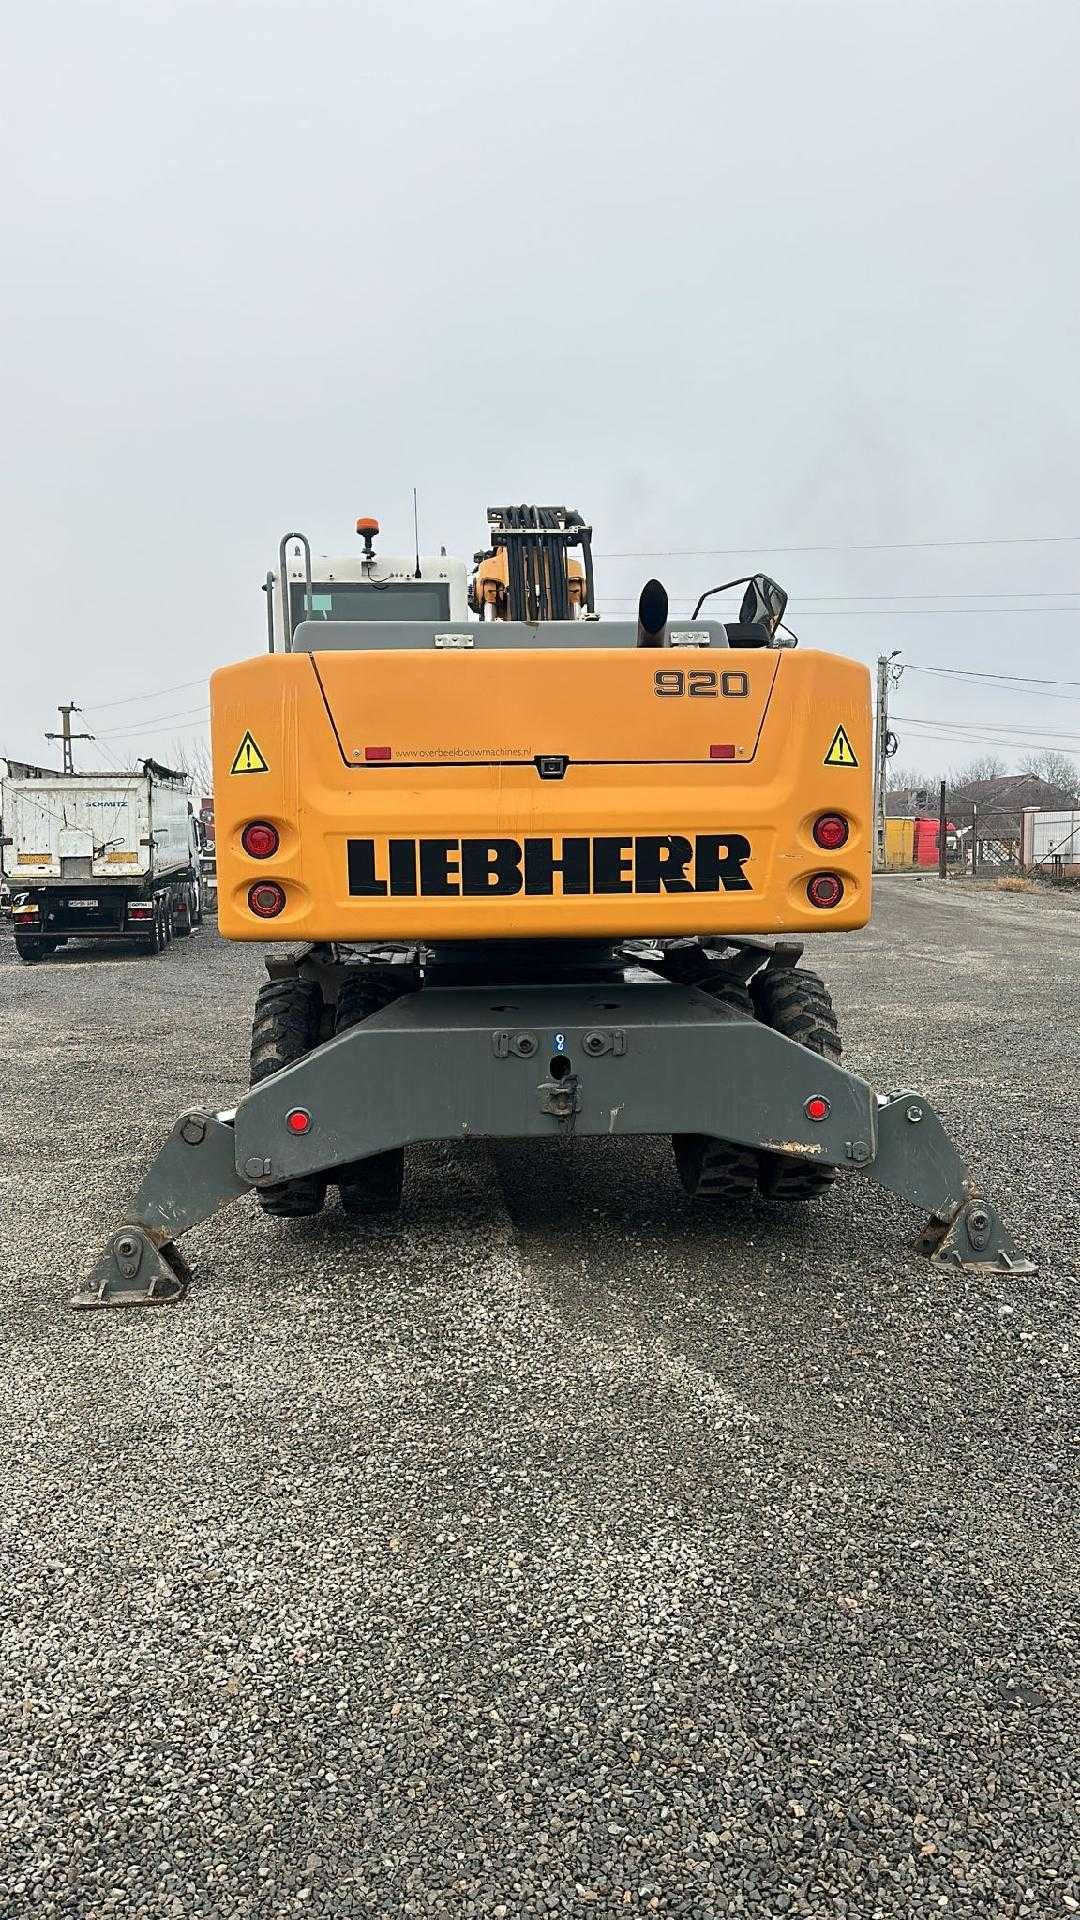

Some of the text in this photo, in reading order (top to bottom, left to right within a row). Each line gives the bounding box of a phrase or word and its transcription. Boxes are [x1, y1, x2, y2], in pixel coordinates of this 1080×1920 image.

[654, 670, 750, 698] 920
[396, 747, 532, 758] www.overbeekbouwmachines.nl
[346, 833, 754, 897] LIEBHERR
